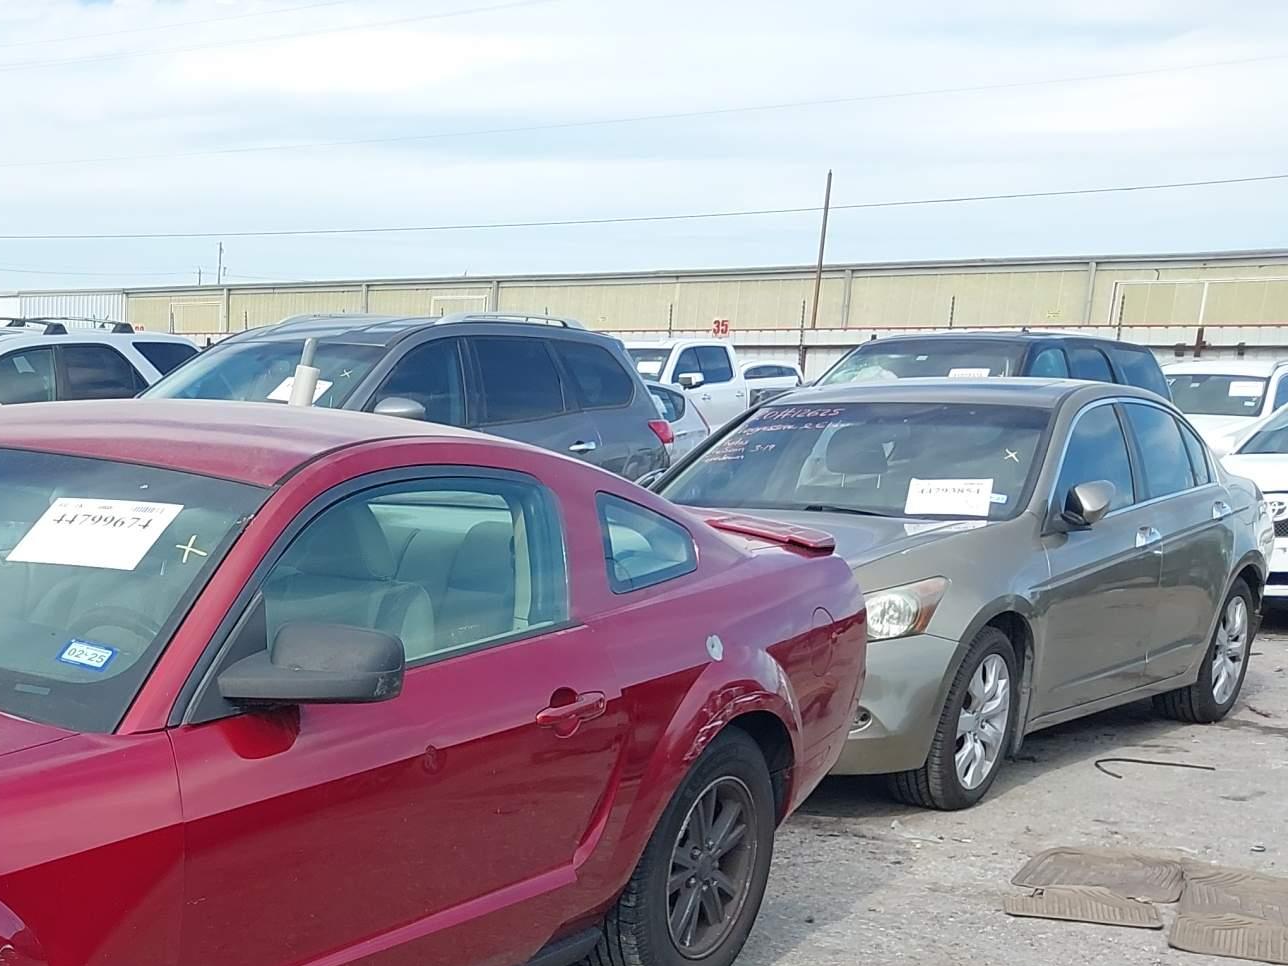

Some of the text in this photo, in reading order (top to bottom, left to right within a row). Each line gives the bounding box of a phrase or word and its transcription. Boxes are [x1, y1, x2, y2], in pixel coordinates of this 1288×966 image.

[713, 319, 729, 335] 35
[52, 512, 154, 530] 44799674
[67, 647, 107, 664] 02-25
